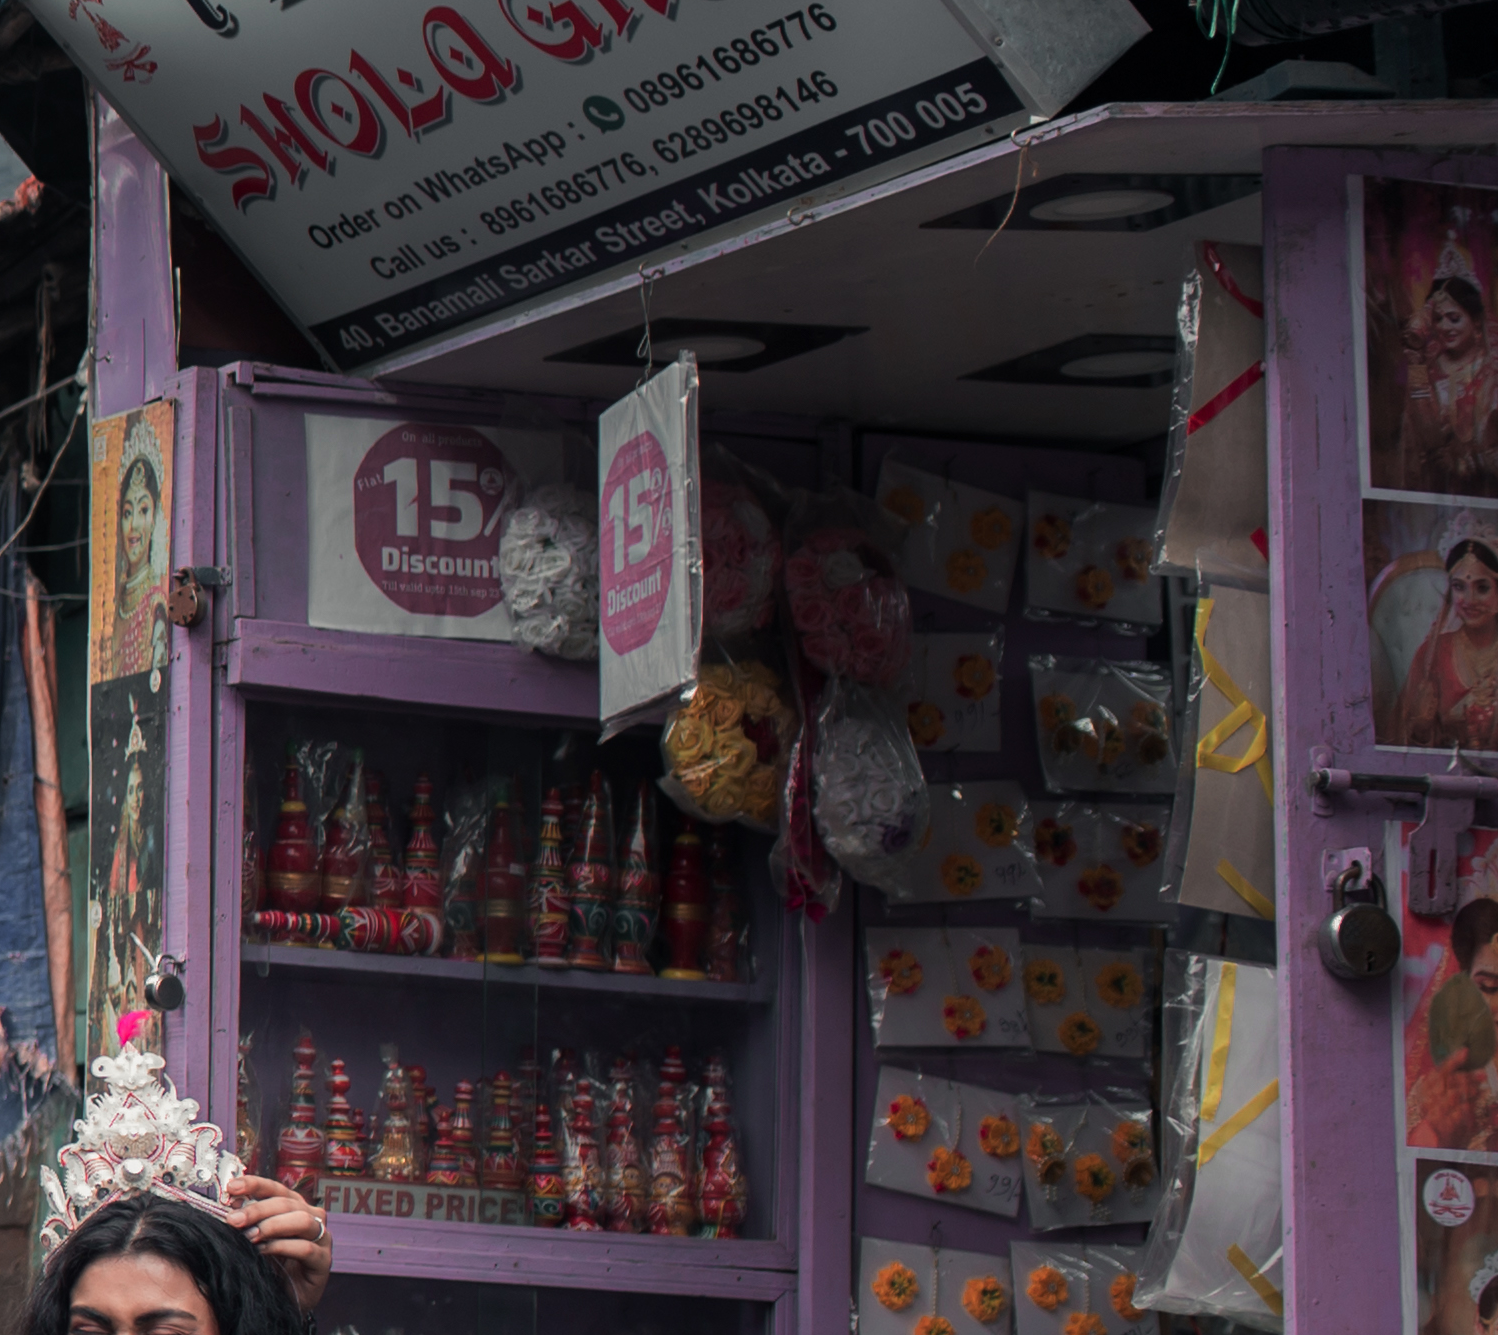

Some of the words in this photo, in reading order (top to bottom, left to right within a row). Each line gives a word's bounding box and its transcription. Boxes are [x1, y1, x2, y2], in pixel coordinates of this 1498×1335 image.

[192, 5, 518, 213] SHOLA
[308, 208, 381, 250] Order
[384, 189, 422, 220] on
[414, 130, 568, 204] WhatsApp
[623, 2, 838, 114] 08961686776
[370, 244, 422, 280] Call
[424, 231, 462, 261] us
[480, 151, 660, 235] 8961686776,
[652, 70, 840, 165] 6289698146
[338, 322, 385, 354] 40,
[375, 276, 505, 339] Banamali
[499, 239, 598, 290] Sarkar
[594, 198, 707, 255] Street,
[697, 151, 832, 214] Kolkata
[845, 109, 917, 157] 700
[916, 82, 988, 130] 005
[401, 430, 416, 443] On
[422, 432, 435, 444] all
[438, 434, 483, 448] products
[357, 473, 383, 492] Flat
[381, 546, 500, 579] Discount
[381, 580, 397, 592] Till
[399, 582, 423, 594] valid
[607, 565, 662, 617] Discount
[324, 1184, 415, 1218] FIXED
[424, 1192, 519, 1225] PRICE
